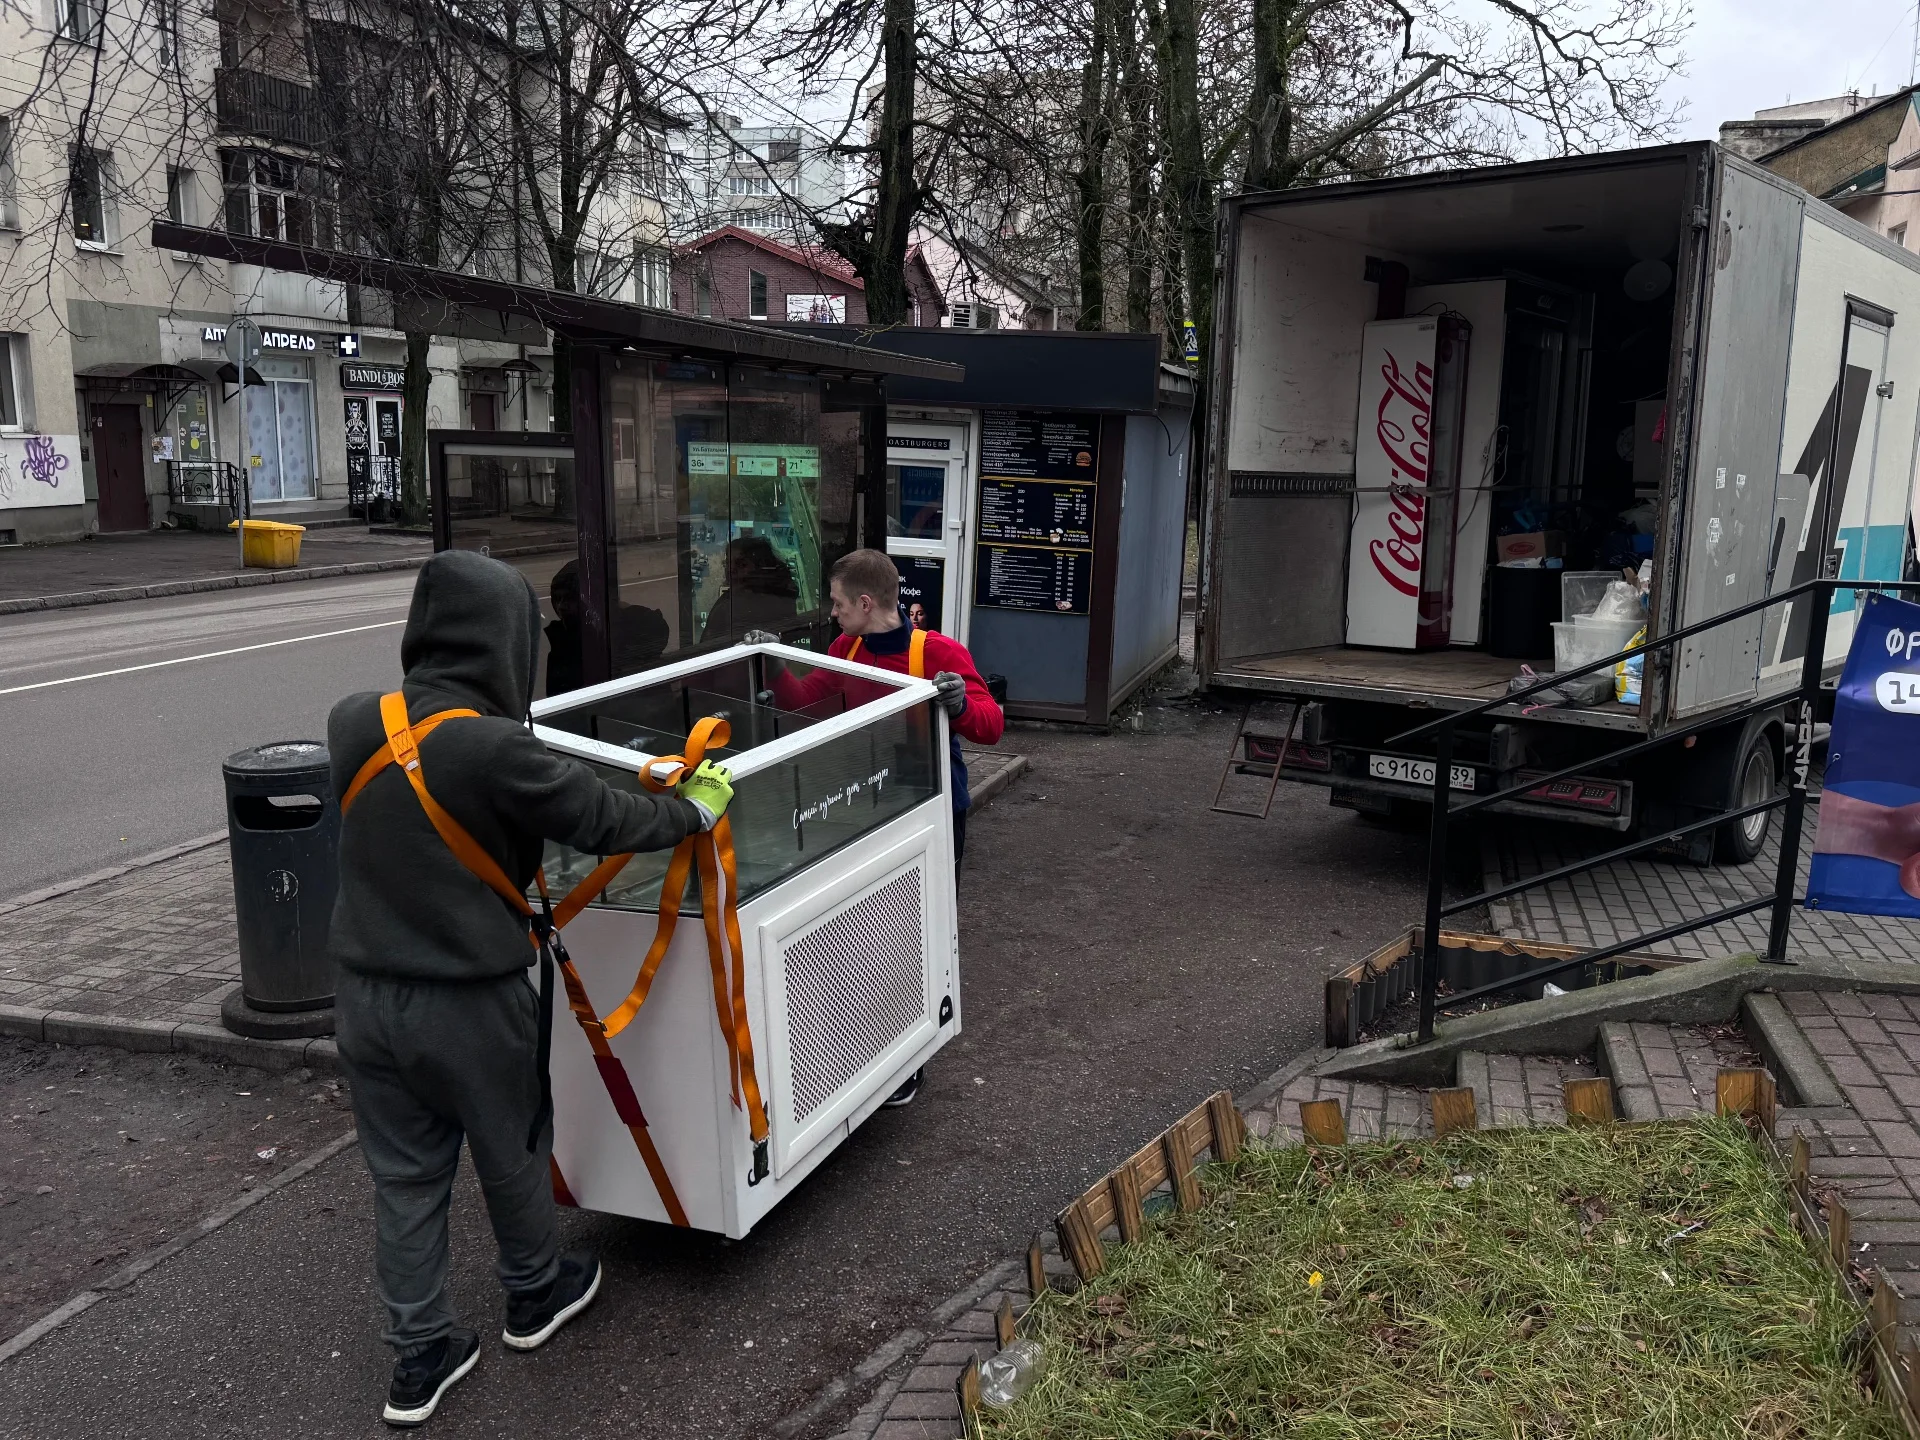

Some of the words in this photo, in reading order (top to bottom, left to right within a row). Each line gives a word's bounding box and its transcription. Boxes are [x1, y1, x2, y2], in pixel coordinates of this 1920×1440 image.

[263, 331, 316, 351] АПРЕЛЬ
[387, 371, 405, 385] BOS
[888, 439, 948, 448] OASTBURGERS
[691, 459, 702, 467] 36
[789, 462, 798, 470] 71
[900, 586, 921, 597] Кофе
[1376, 760, 1434, 782] C916O
[1451, 767, 1469, 783] 39
